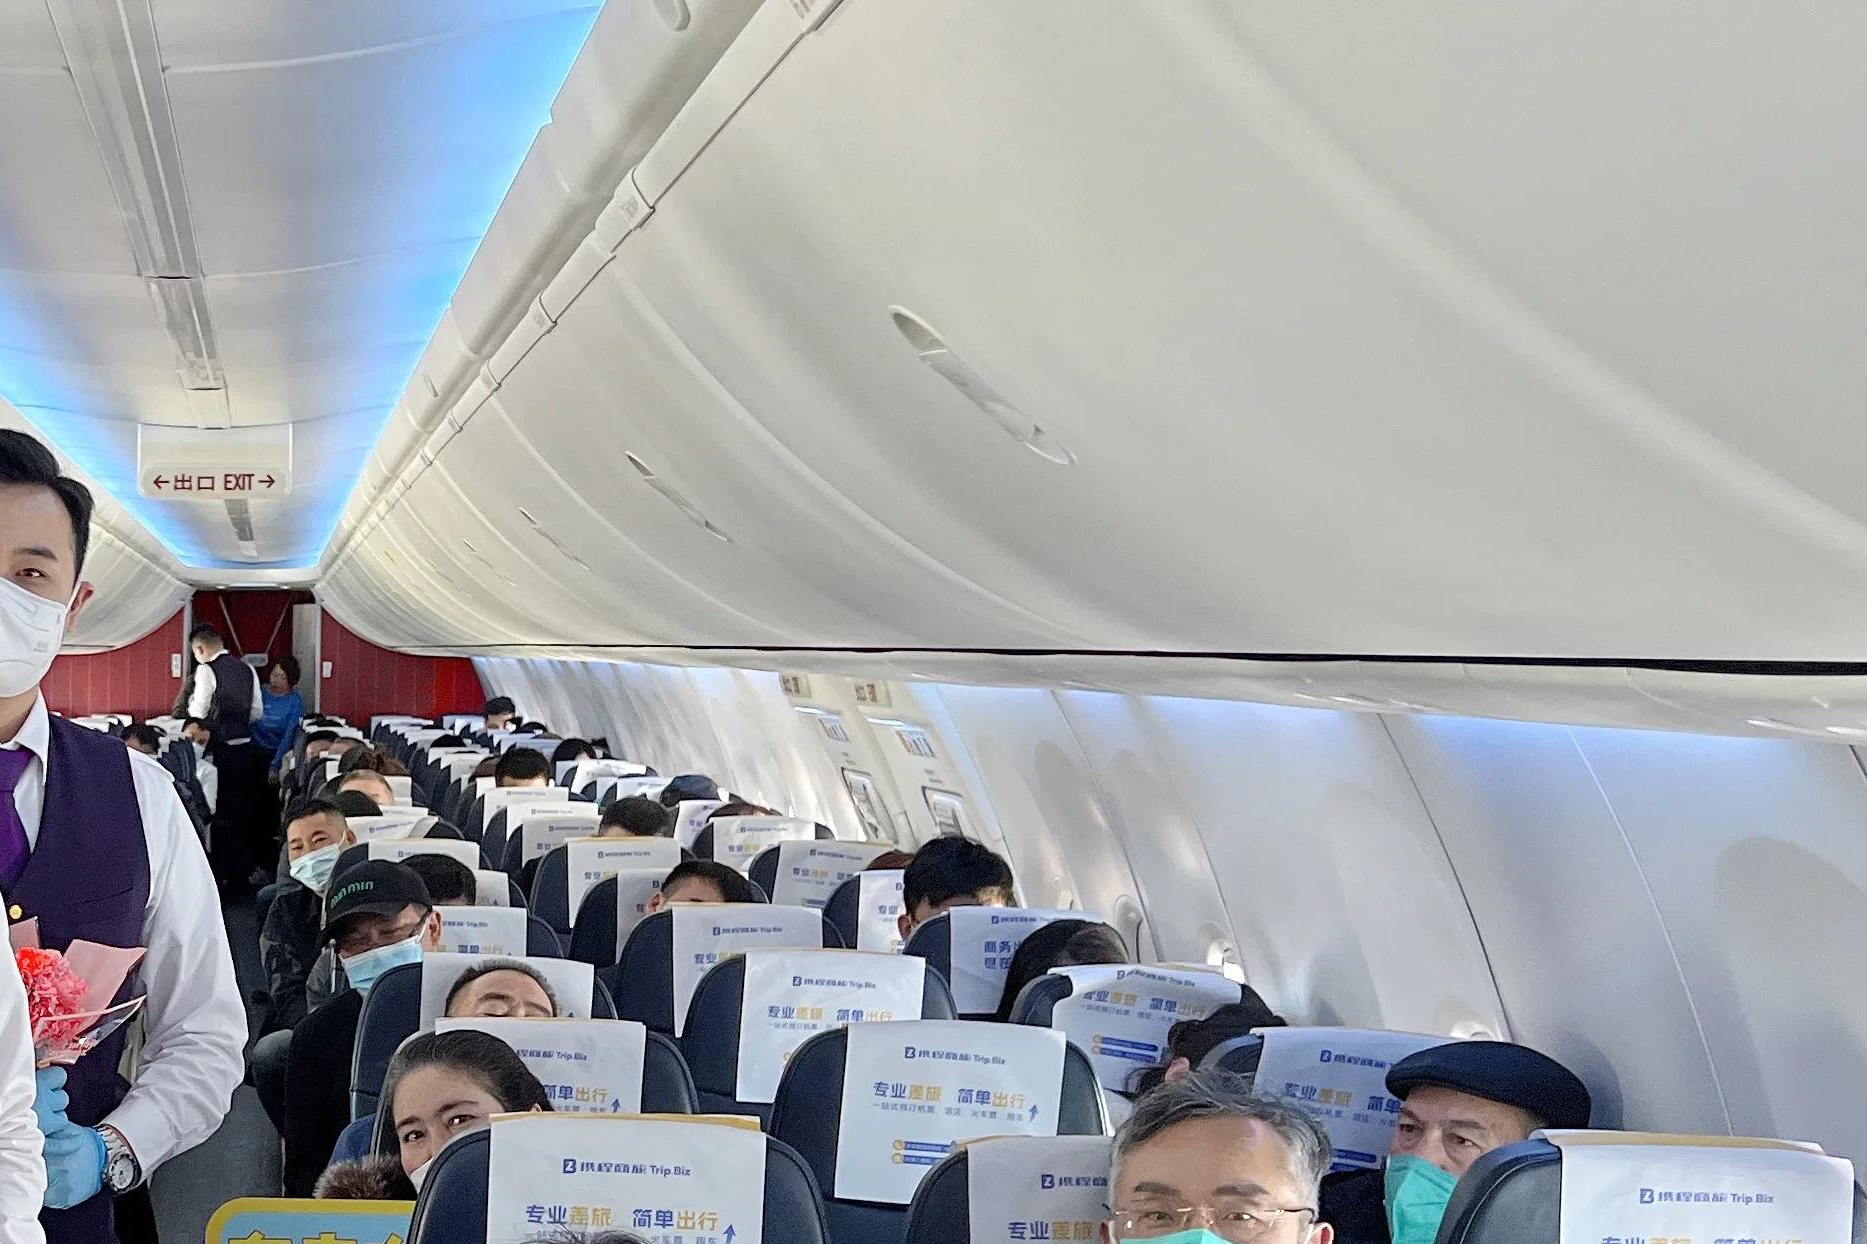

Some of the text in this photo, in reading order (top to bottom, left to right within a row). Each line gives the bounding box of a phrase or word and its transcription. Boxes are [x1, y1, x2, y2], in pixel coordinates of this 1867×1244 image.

[173, 473, 255, 491] 出口 EXIT
[633, 1208, 719, 1232] 简单出行
